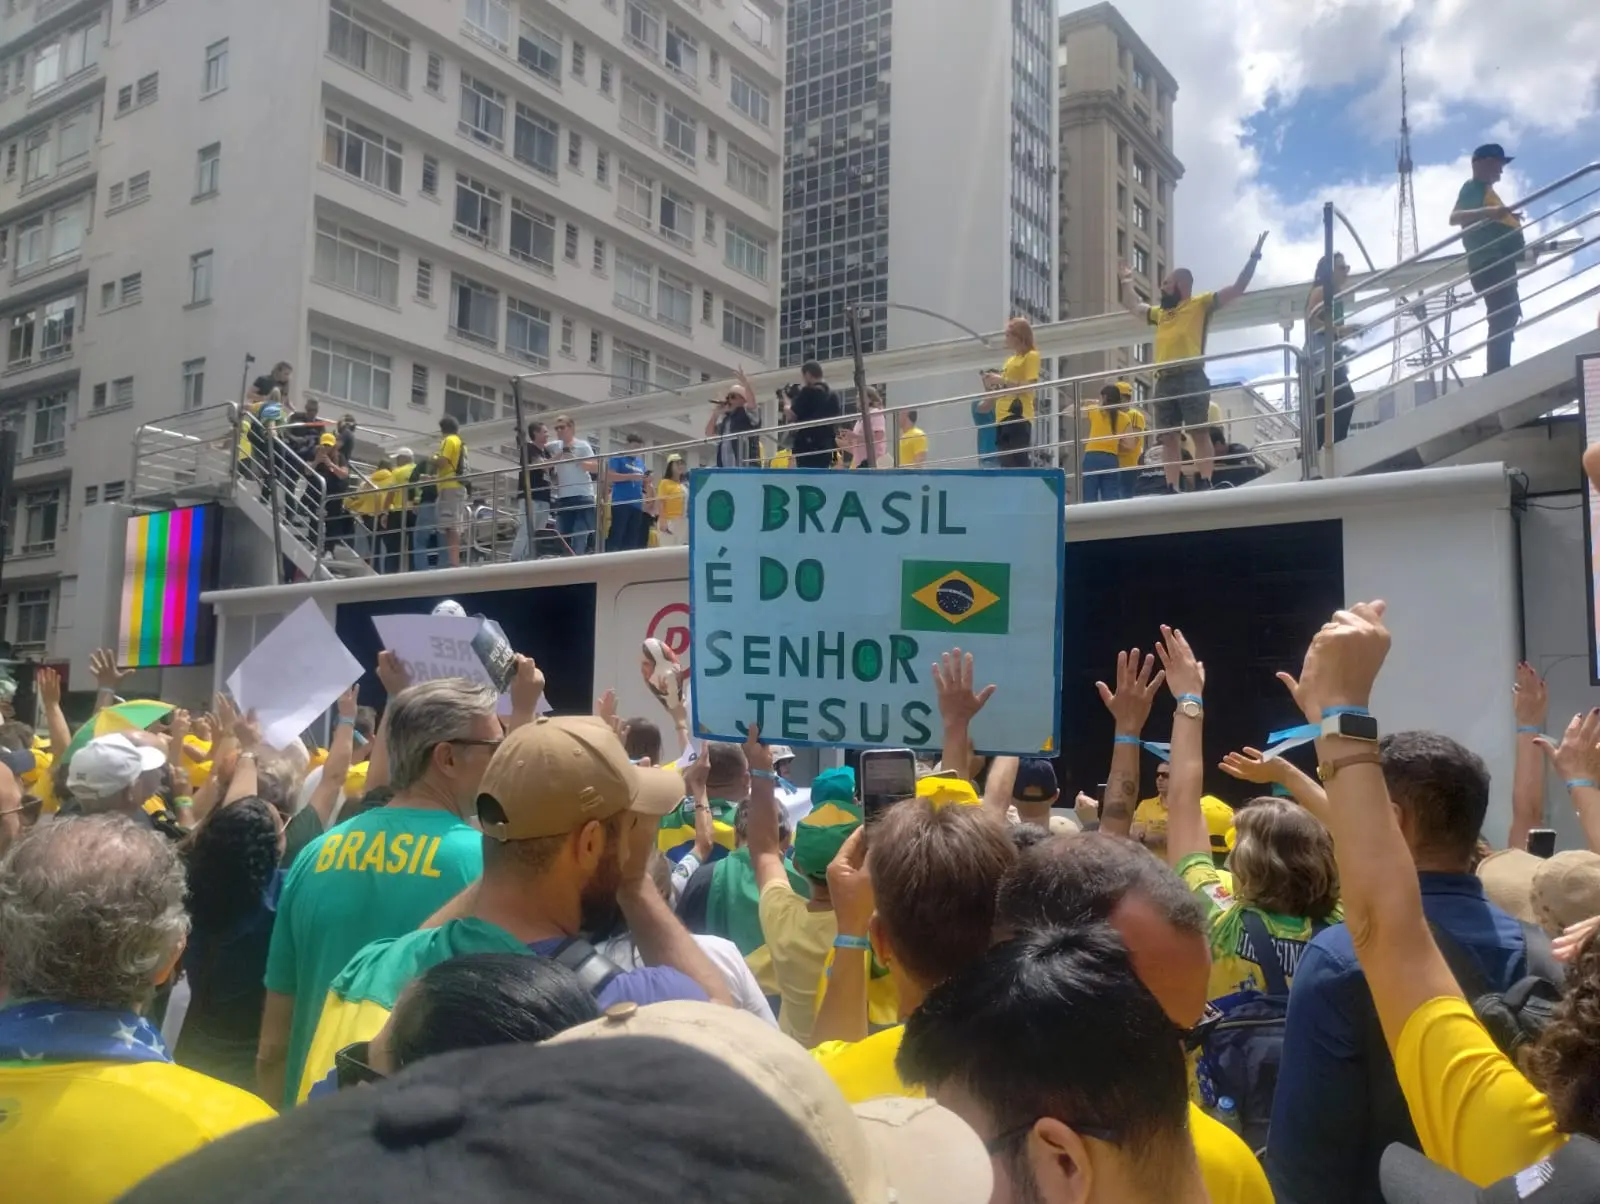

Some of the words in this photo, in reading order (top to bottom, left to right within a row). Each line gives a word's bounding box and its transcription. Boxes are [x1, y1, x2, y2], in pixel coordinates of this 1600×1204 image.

[707, 489, 735, 532] O
[705, 546, 733, 603] É
[760, 556, 824, 602] DO
[704, 630, 919, 684] SENHOR
[735, 692, 932, 746] JESUS
[315, 831, 442, 878] BRASIL
